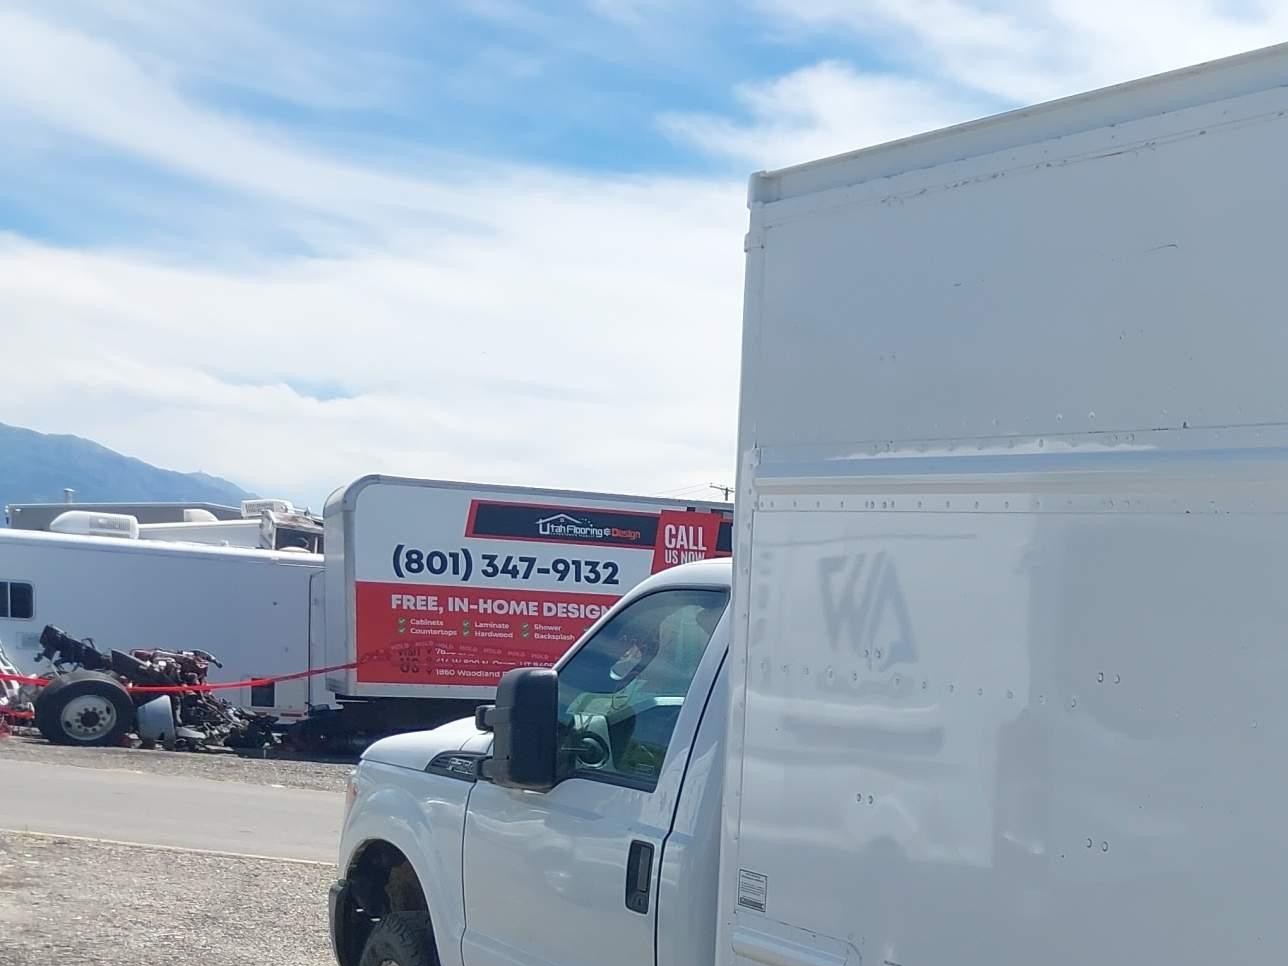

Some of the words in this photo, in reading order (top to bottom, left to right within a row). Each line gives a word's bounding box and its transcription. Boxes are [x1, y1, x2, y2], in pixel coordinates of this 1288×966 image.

[539, 522, 566, 535] Utah
[567, 524, 603, 538] Flooring
[612, 528, 641, 540] Design
[664, 524, 707, 551] CALL
[665, 550, 678, 564] US
[681, 552, 705, 563] NOW
[392, 544, 473, 582] (801)
[481, 553, 620, 585] 347-9132
[391, 594, 444, 614] FREE,
[448, 597, 539, 617] IN-HOME
[410, 618, 444, 626] Cabinets
[475, 622, 510, 630] Laminate
[410, 628, 457, 636] Countertops
[534, 624, 562, 632] Shower
[534, 633, 575, 641] Backsplash
[458, 670, 501, 678] Woodland
